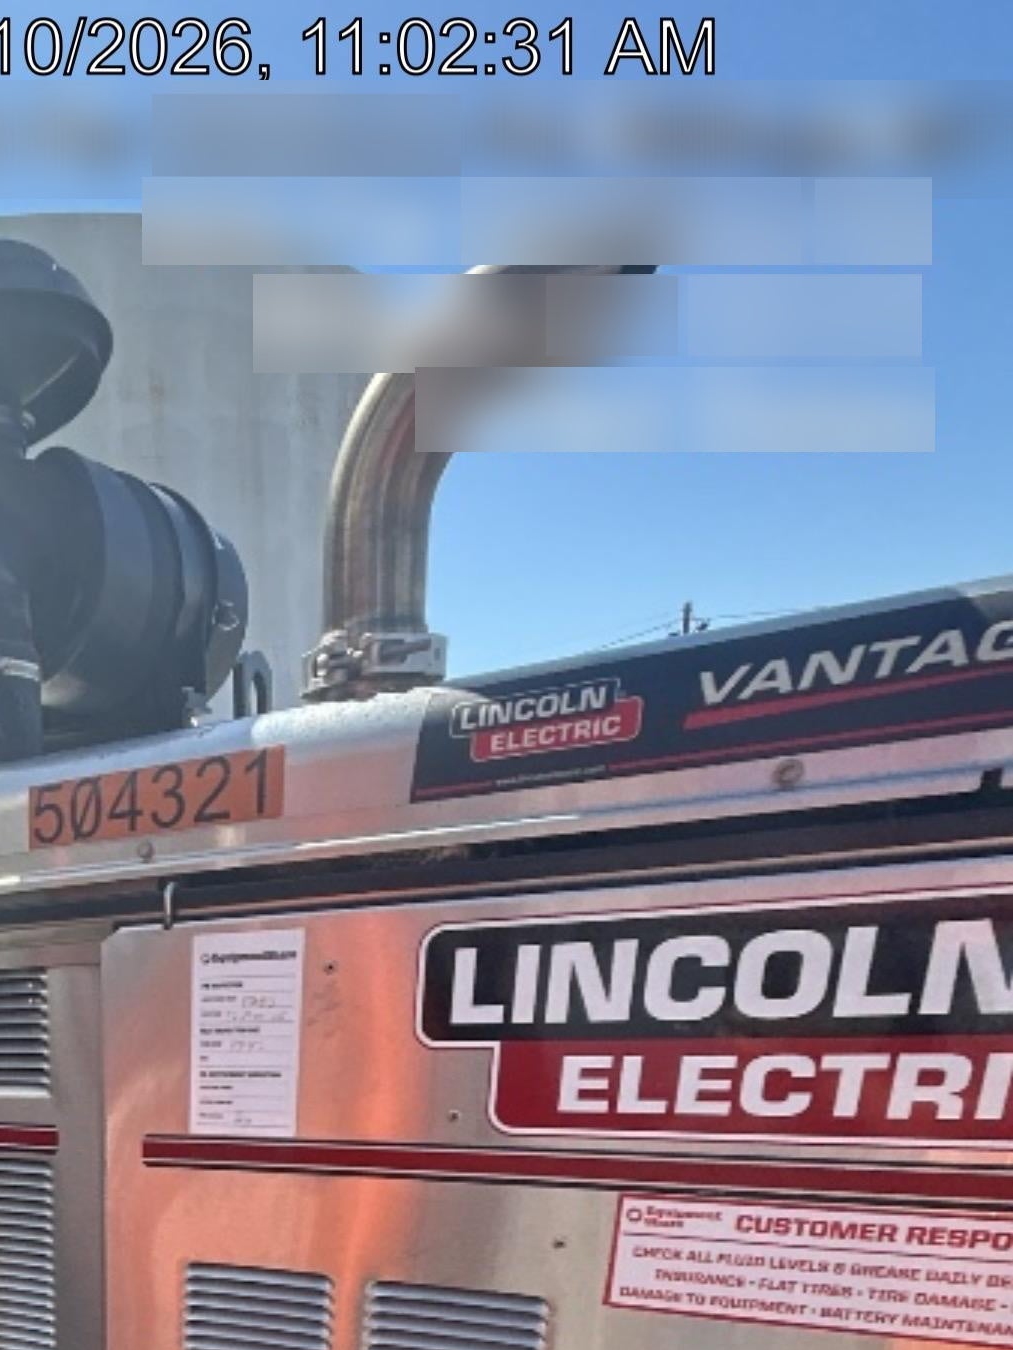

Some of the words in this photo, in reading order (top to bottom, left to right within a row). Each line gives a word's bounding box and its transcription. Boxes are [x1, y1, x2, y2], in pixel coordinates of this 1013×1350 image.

[460, 686, 608, 730] LINCOLN
[490, 716, 621, 753] ELECTRIC
[34, 748, 268, 843] 504321
[555, 1052, 1013, 1120] ELECTRI
[735, 1214, 899, 1243] CUSTOMER
[906, 1225, 1013, 1252] RESPO
[633, 1245, 682, 1261] CHECK
[686, 1250, 713, 1264] ALL
[769, 1256, 830, 1274] LEVELS
[619, 1286, 682, 1302] DAMAGE
[710, 1295, 808, 1315] EQUIPMENT
[820, 1306, 899, 1326] BATTERY
[758, 1277, 797, 1294] FLAT
[868, 1286, 909, 1303] TIRE
